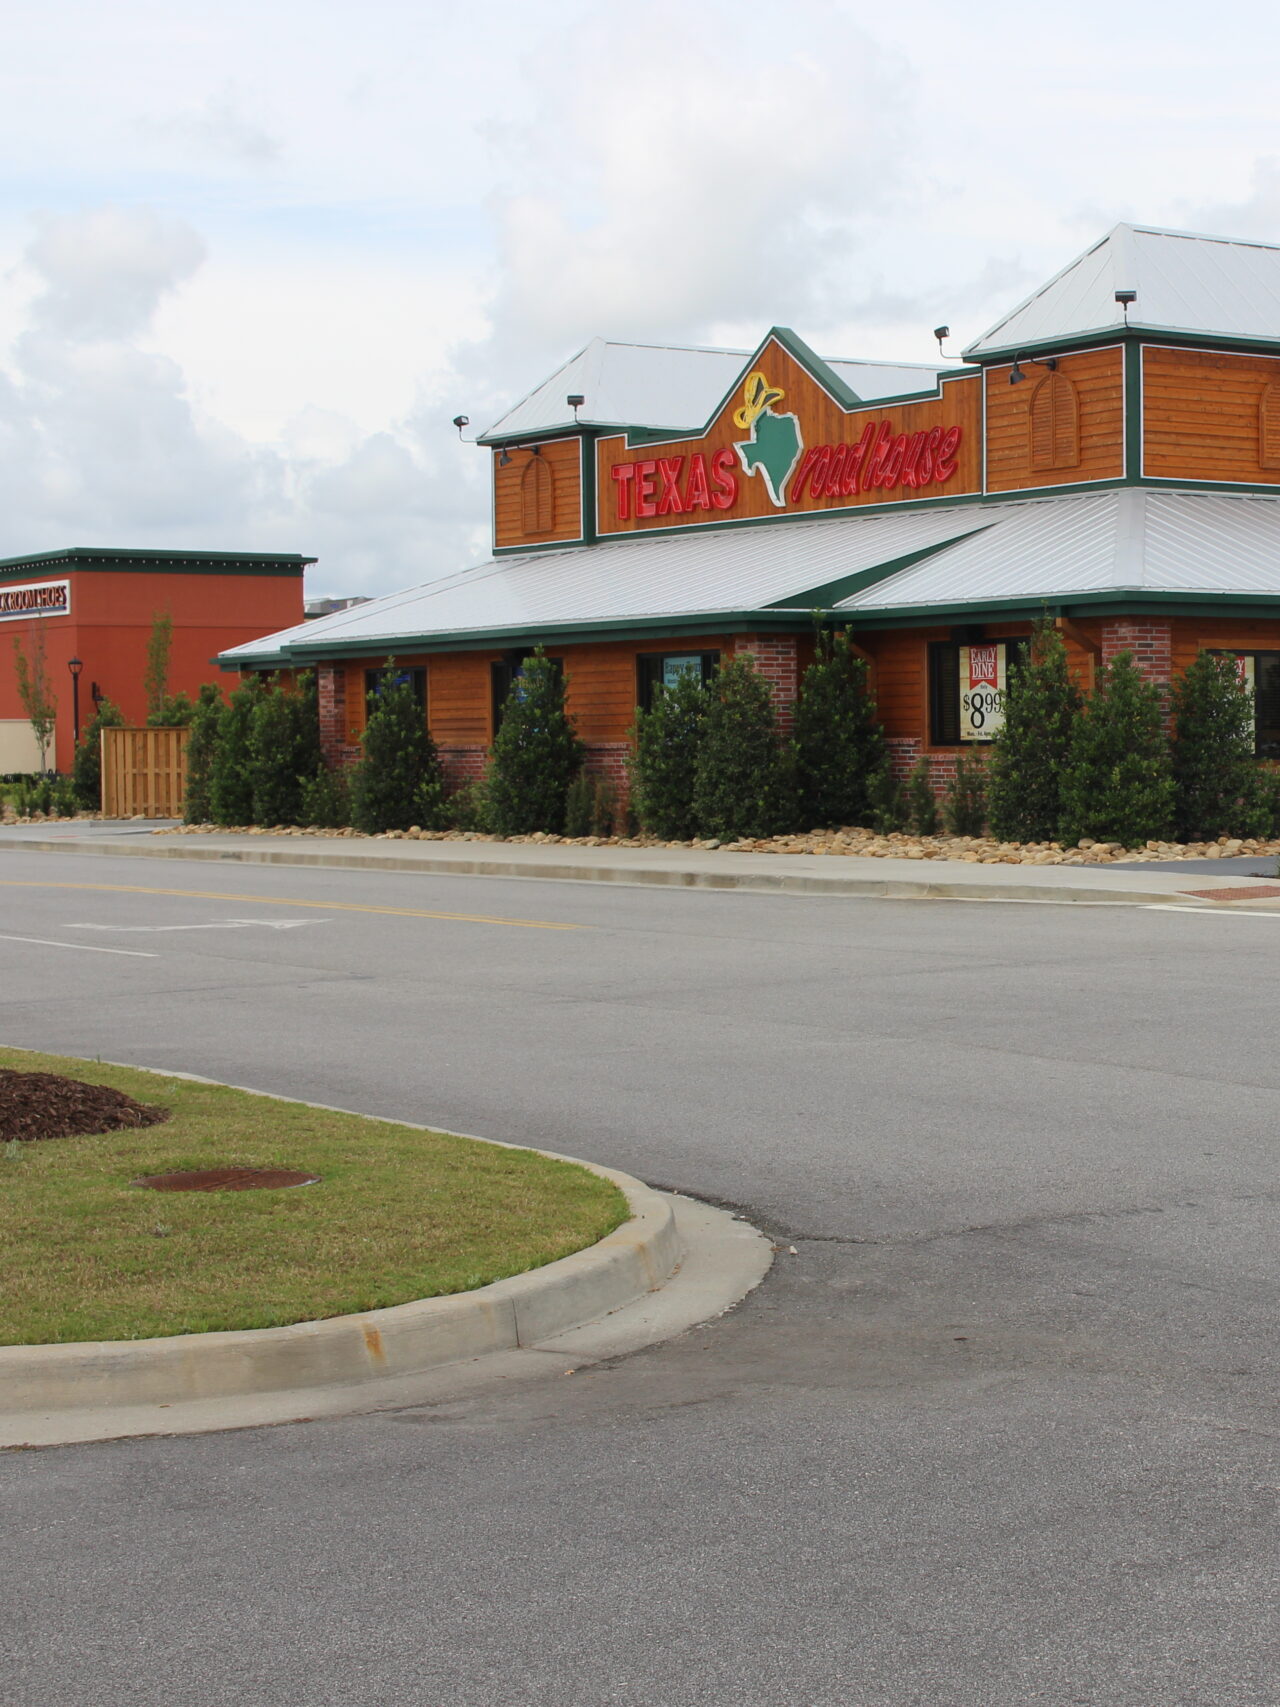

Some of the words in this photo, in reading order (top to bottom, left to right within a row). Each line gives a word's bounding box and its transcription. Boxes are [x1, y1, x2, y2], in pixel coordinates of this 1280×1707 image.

[611, 448, 738, 520] TEXAS
[10, 589, 38, 611] ROOM
[37, 585, 67, 607] SHOES
[970, 647, 996, 663] EARLY
[972, 662, 995, 679] DINE
